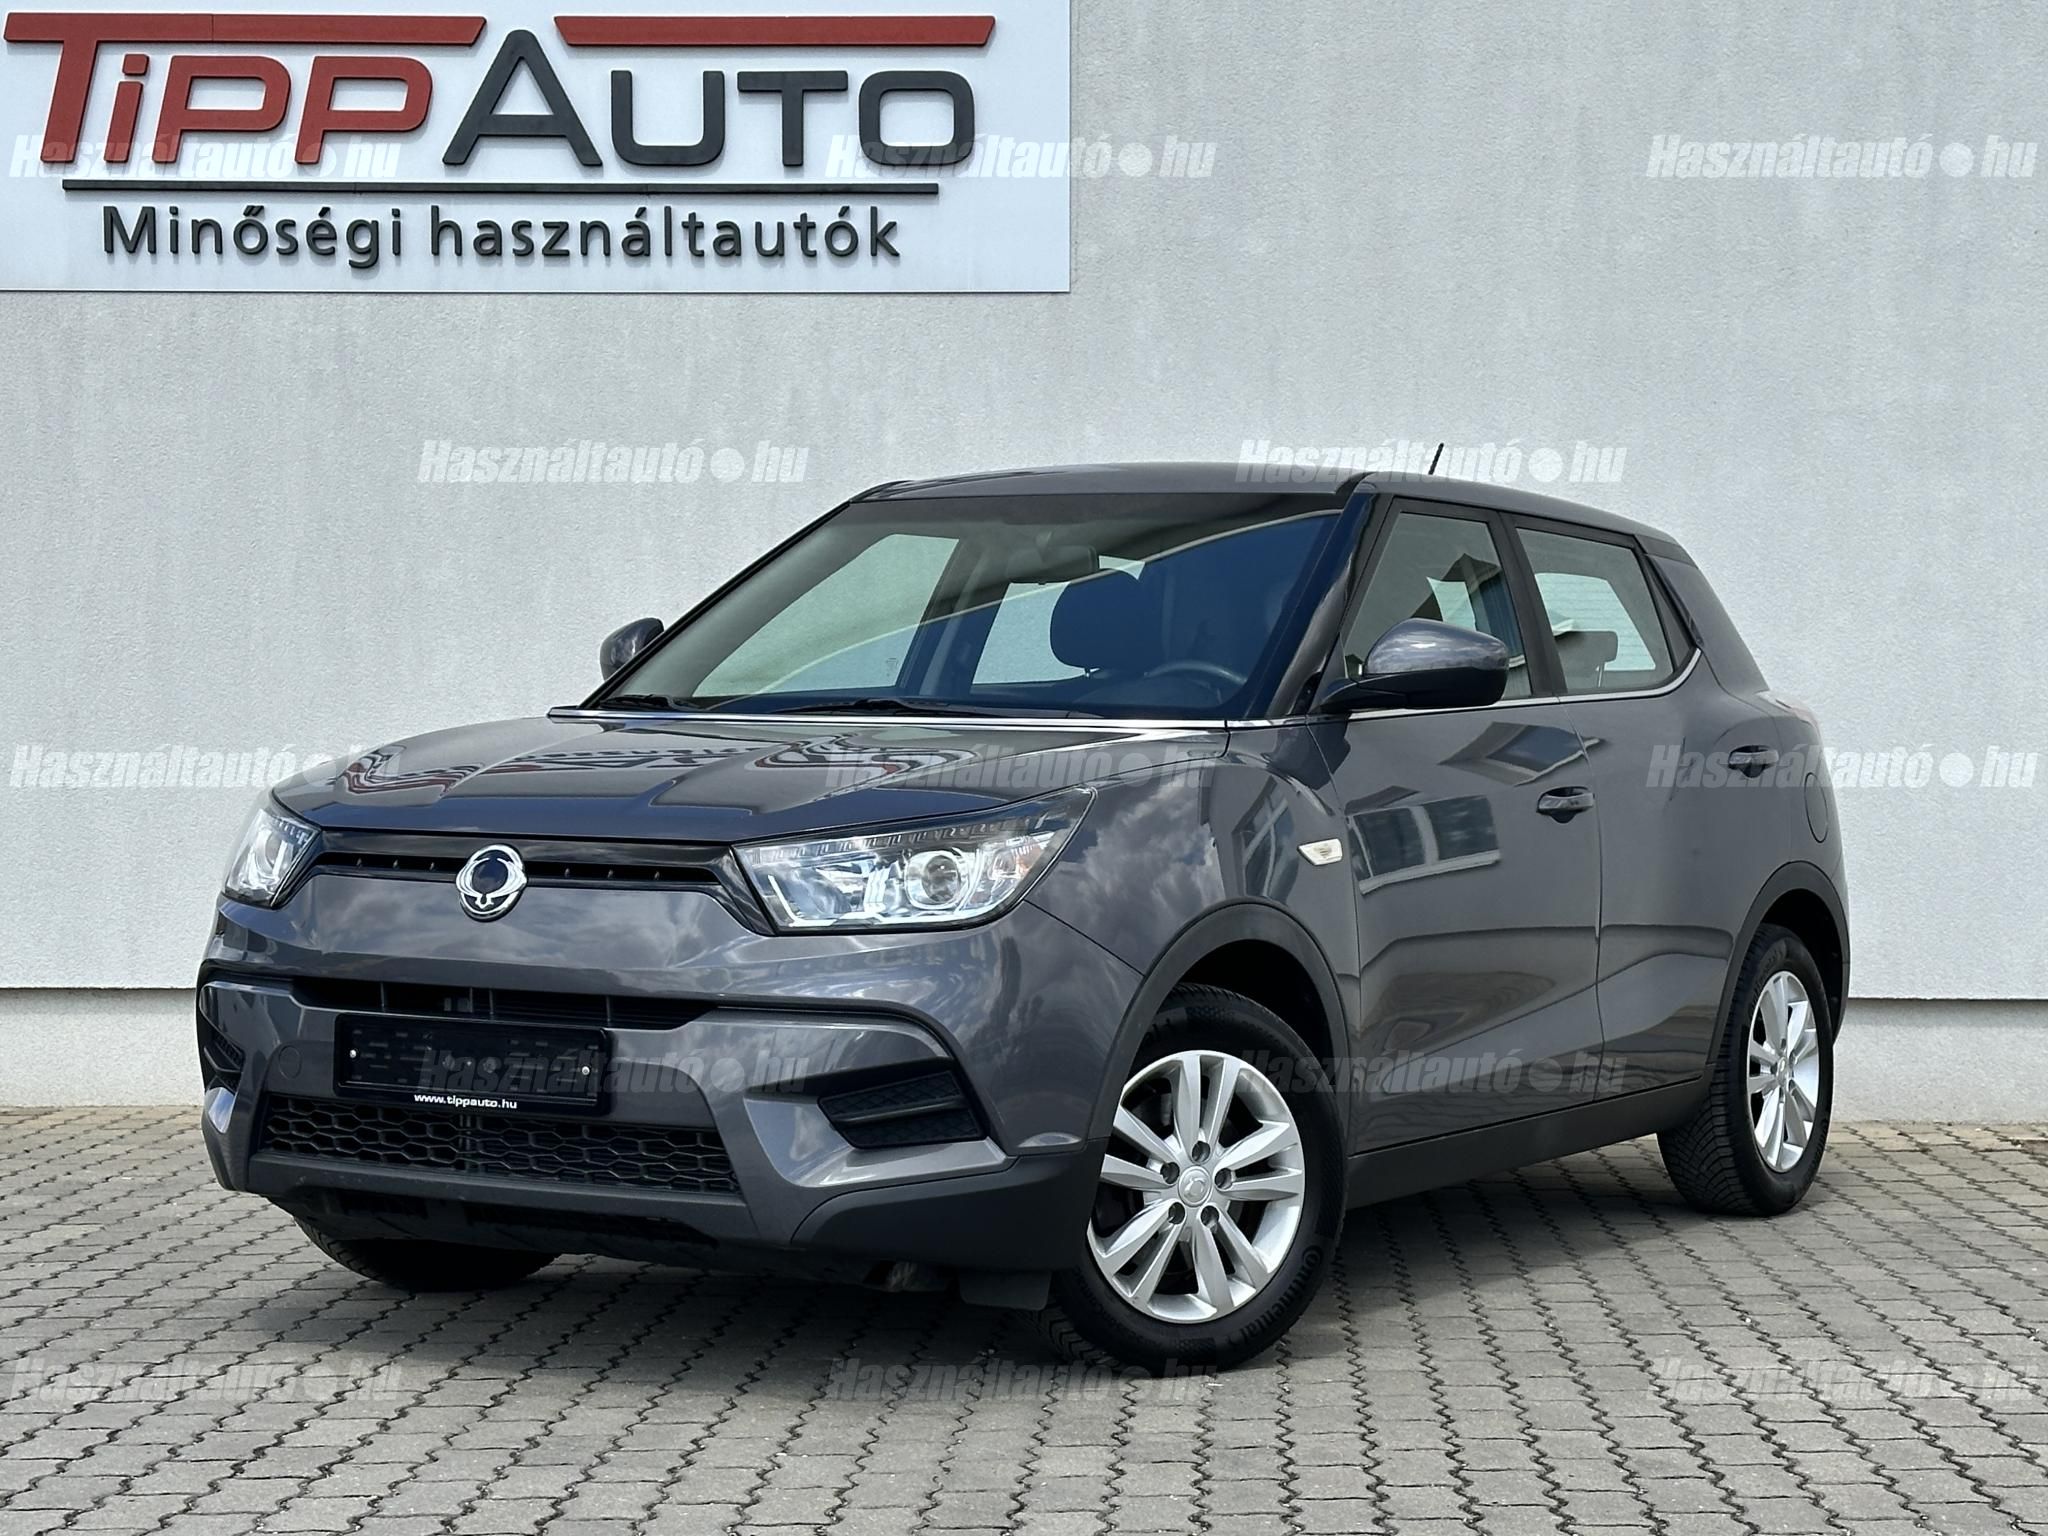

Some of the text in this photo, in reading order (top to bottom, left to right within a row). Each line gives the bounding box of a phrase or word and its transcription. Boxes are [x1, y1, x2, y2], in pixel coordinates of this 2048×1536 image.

[102, 204, 901, 269] Minőségi használtautók
[413, 1092, 519, 1110] www.tippauto.hu
